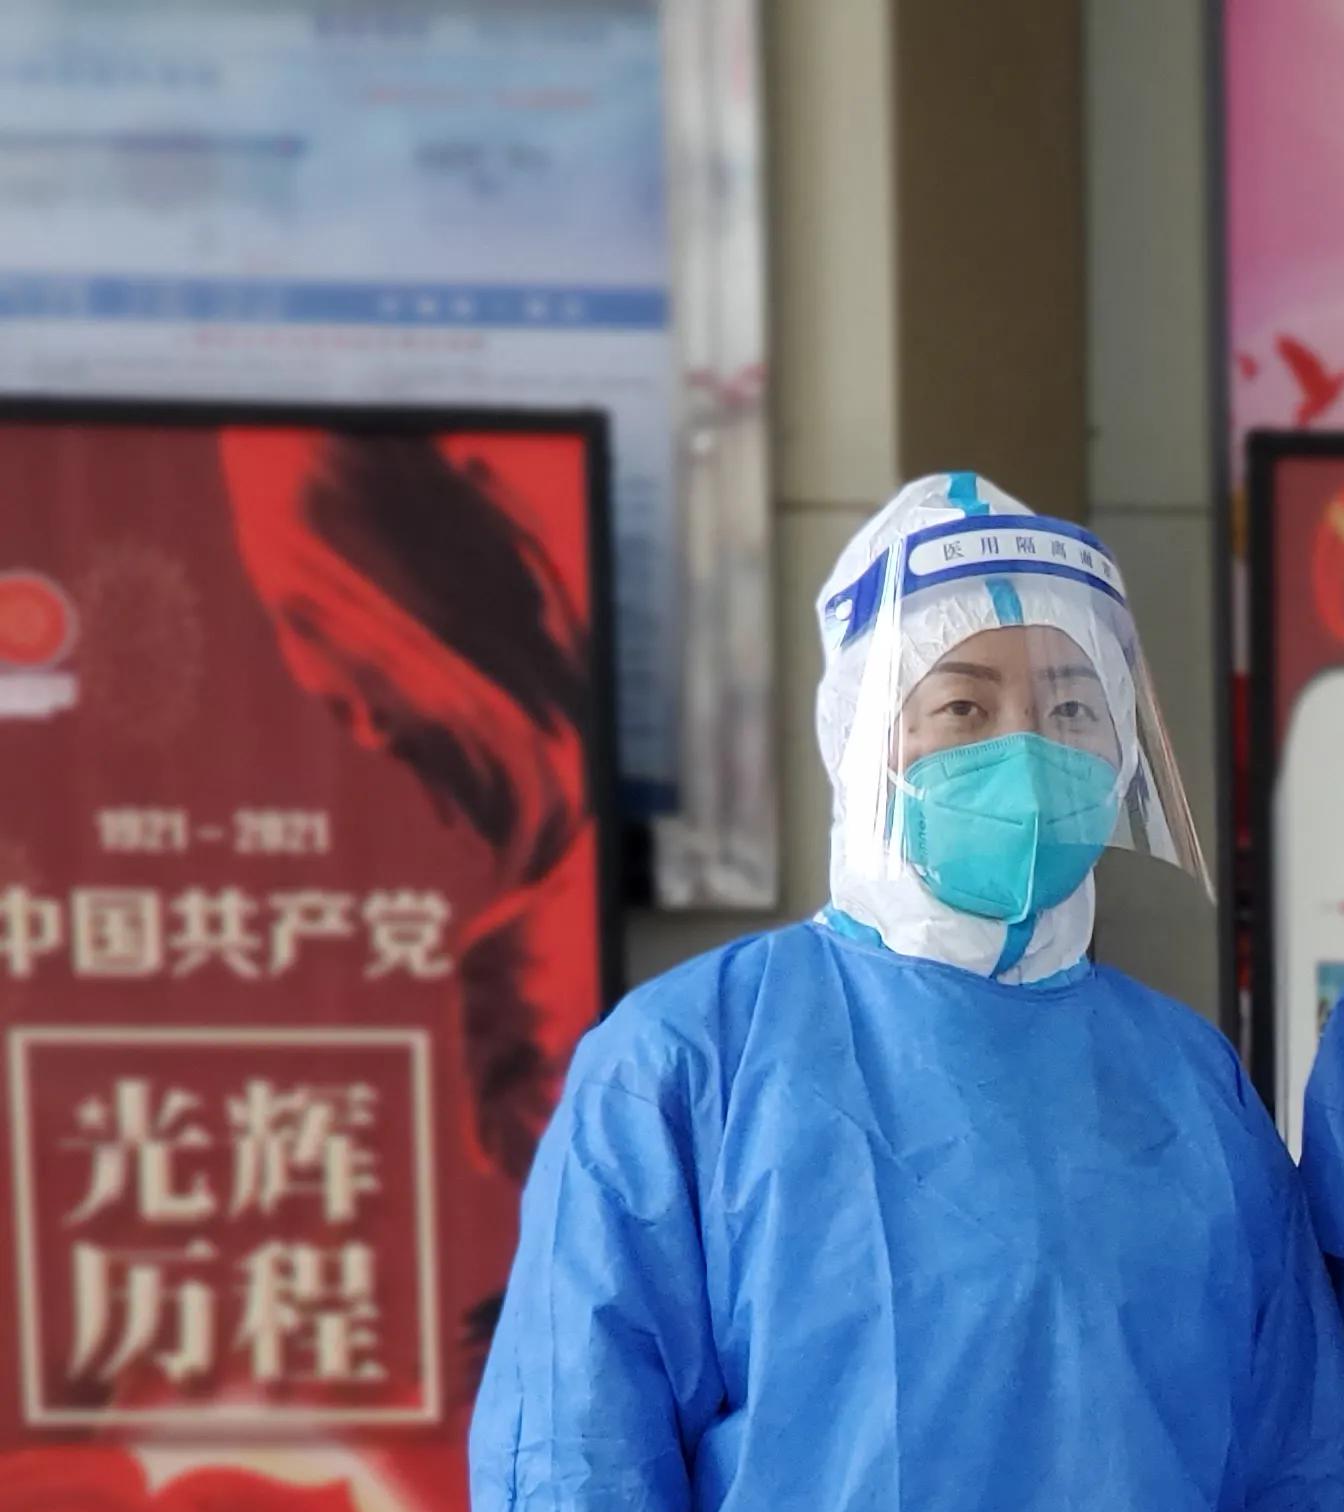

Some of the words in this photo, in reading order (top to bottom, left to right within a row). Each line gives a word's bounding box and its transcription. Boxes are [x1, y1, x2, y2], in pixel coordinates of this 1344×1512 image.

[0, 886, 453, 980] 中国共产党
[61, 1077, 382, 1225] 光辉
[66, 1240, 386, 1383] 历程
